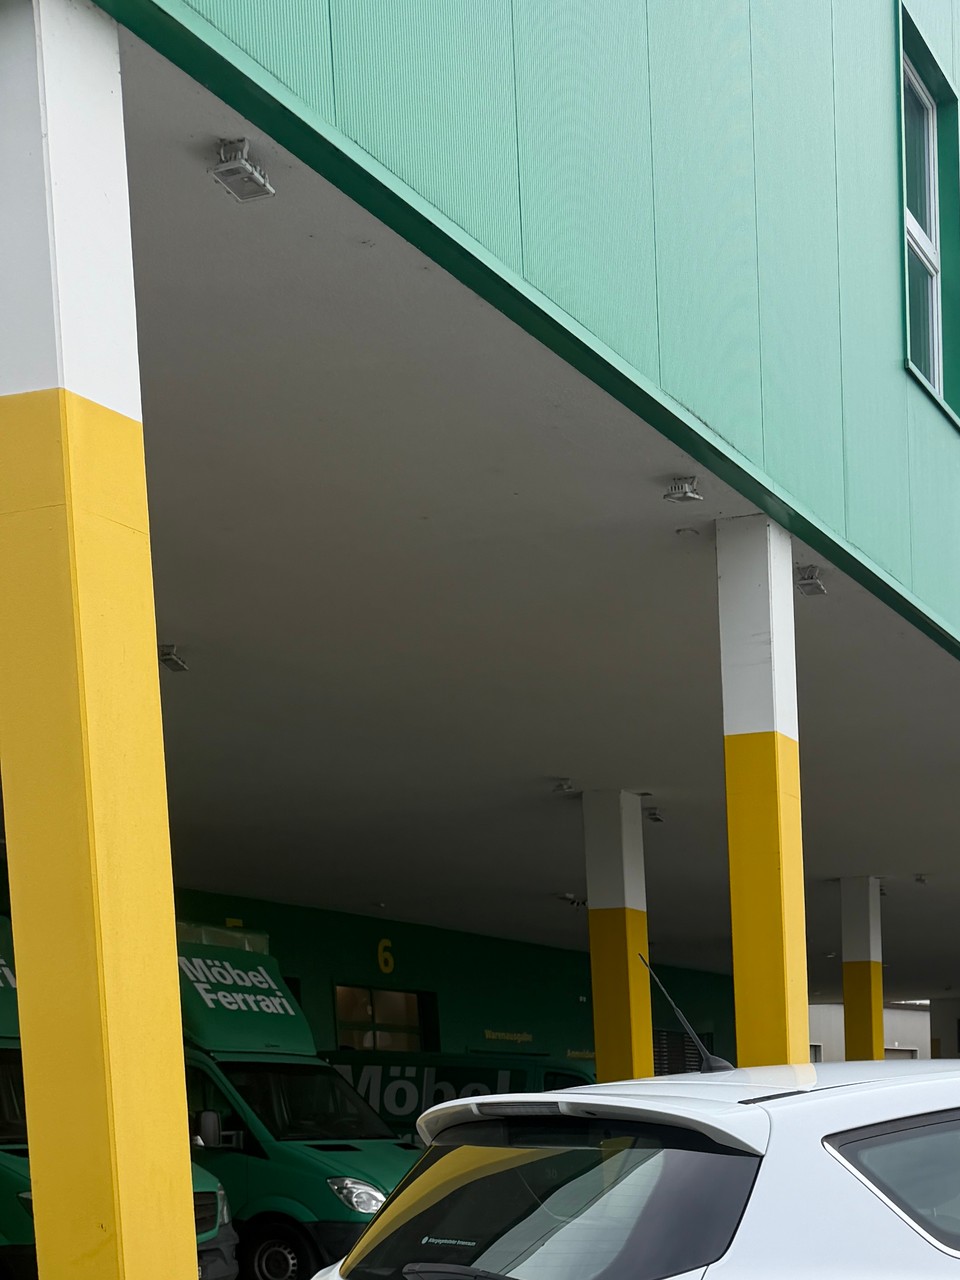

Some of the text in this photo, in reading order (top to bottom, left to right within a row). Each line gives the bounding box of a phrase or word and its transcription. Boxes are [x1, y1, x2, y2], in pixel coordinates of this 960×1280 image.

[178, 956, 279, 990] Möbel
[377, 938, 395, 974] 6
[193, 982, 296, 1016] Ferrari
